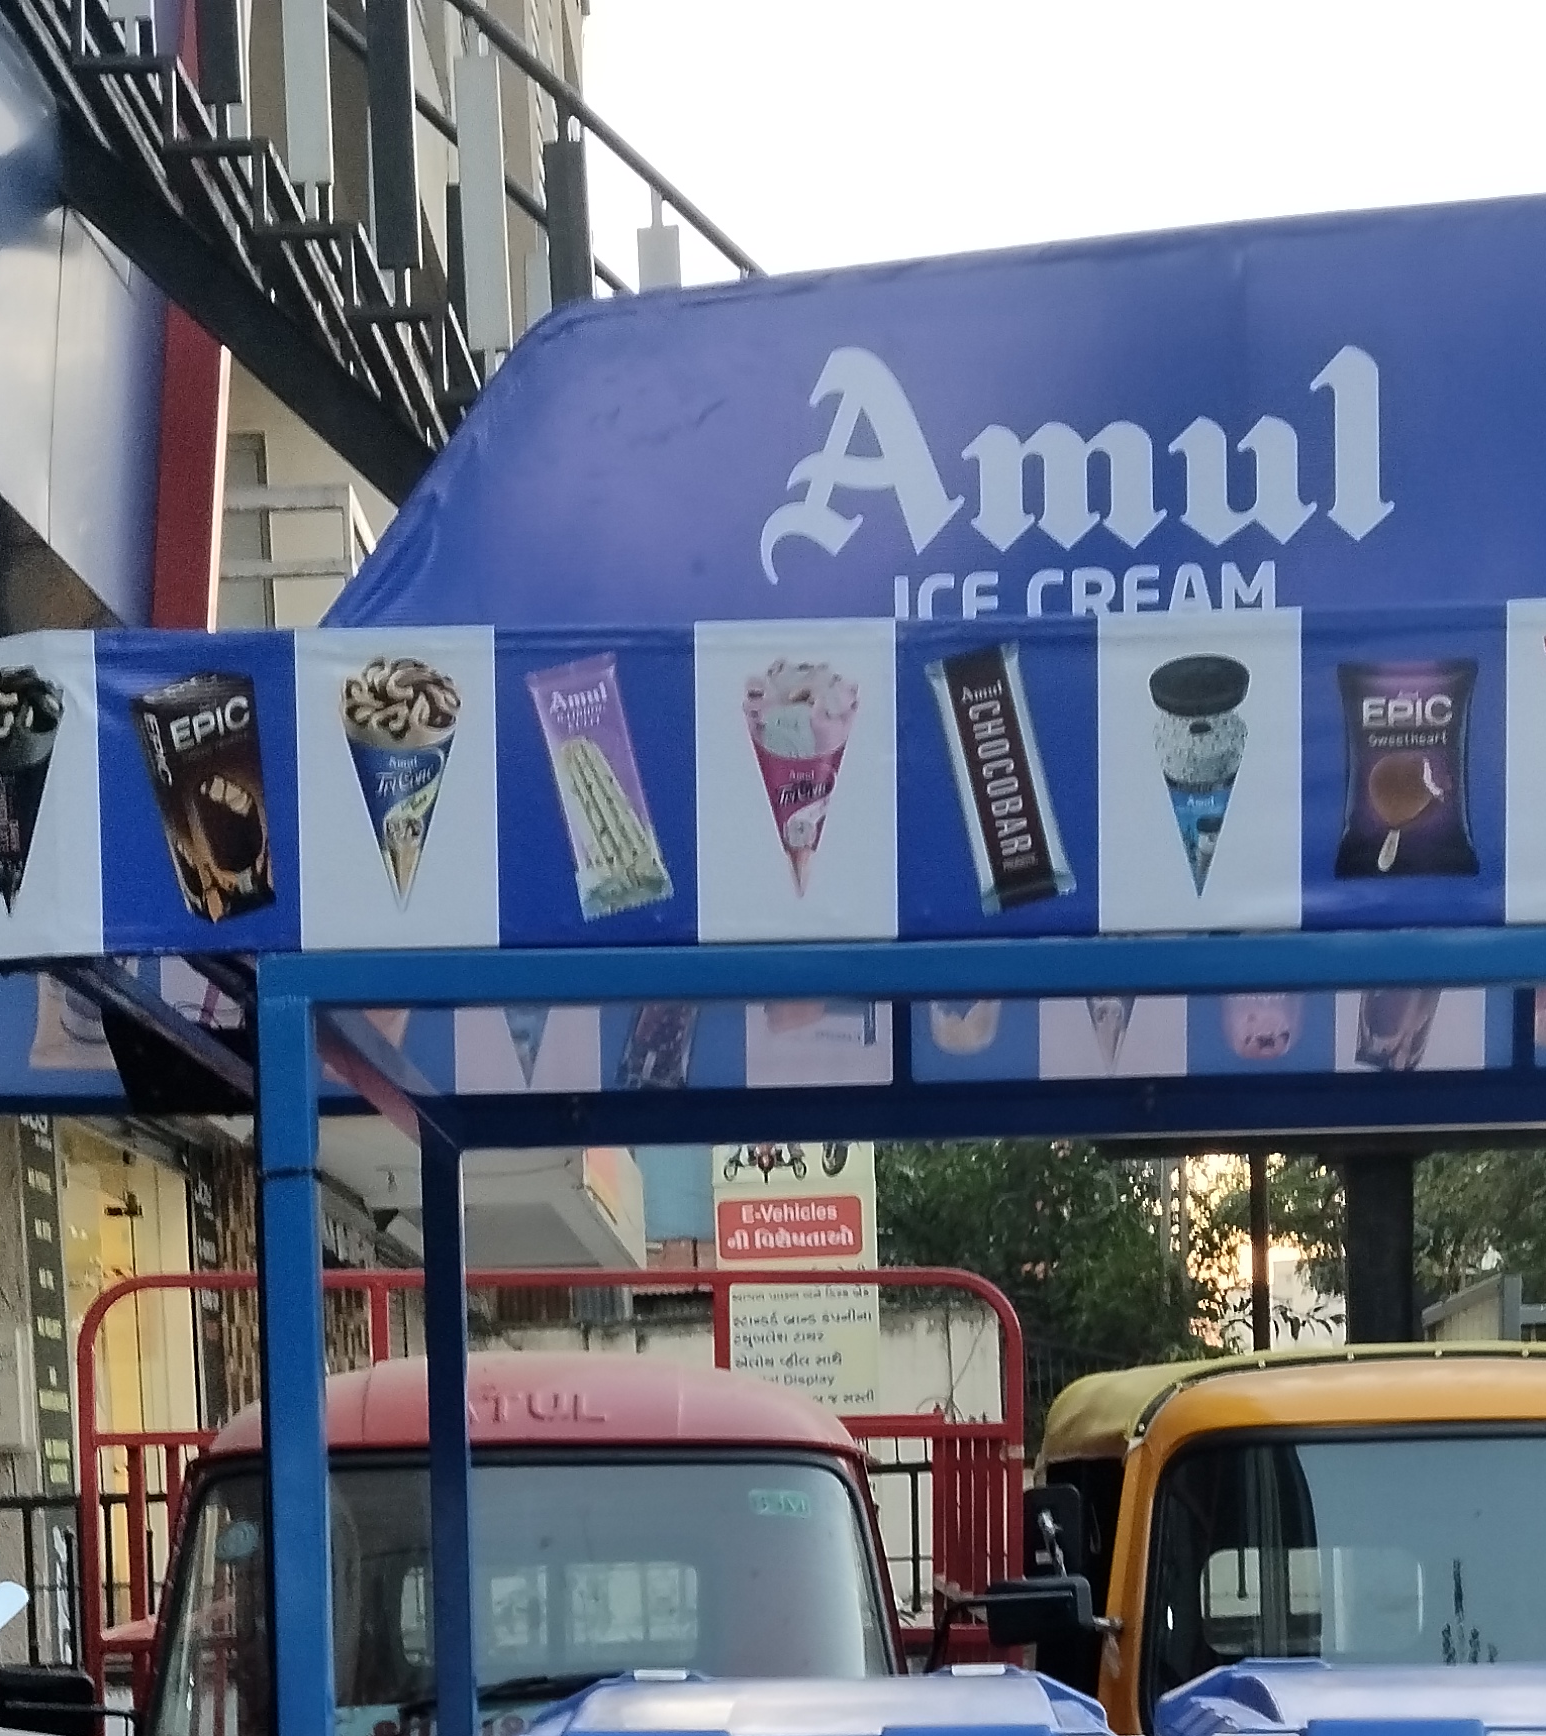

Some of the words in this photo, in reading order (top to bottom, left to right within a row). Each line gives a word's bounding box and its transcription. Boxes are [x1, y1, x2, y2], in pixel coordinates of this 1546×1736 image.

[761, 344, 1395, 586] Amul
[893, 571, 999, 620] ICE
[1026, 560, 1278, 618] CREAM
[549, 681, 608, 715] Amul
[1362, 693, 1453, 729] EPIC
[170, 695, 251, 753] EPIC
[1368, 729, 1450, 748] Sweetheart
[968, 700, 1033, 857] CHOCOBAR
[740, 1201, 839, 1224] E-Vehicles
[783, 1374, 835, 1387] Display
